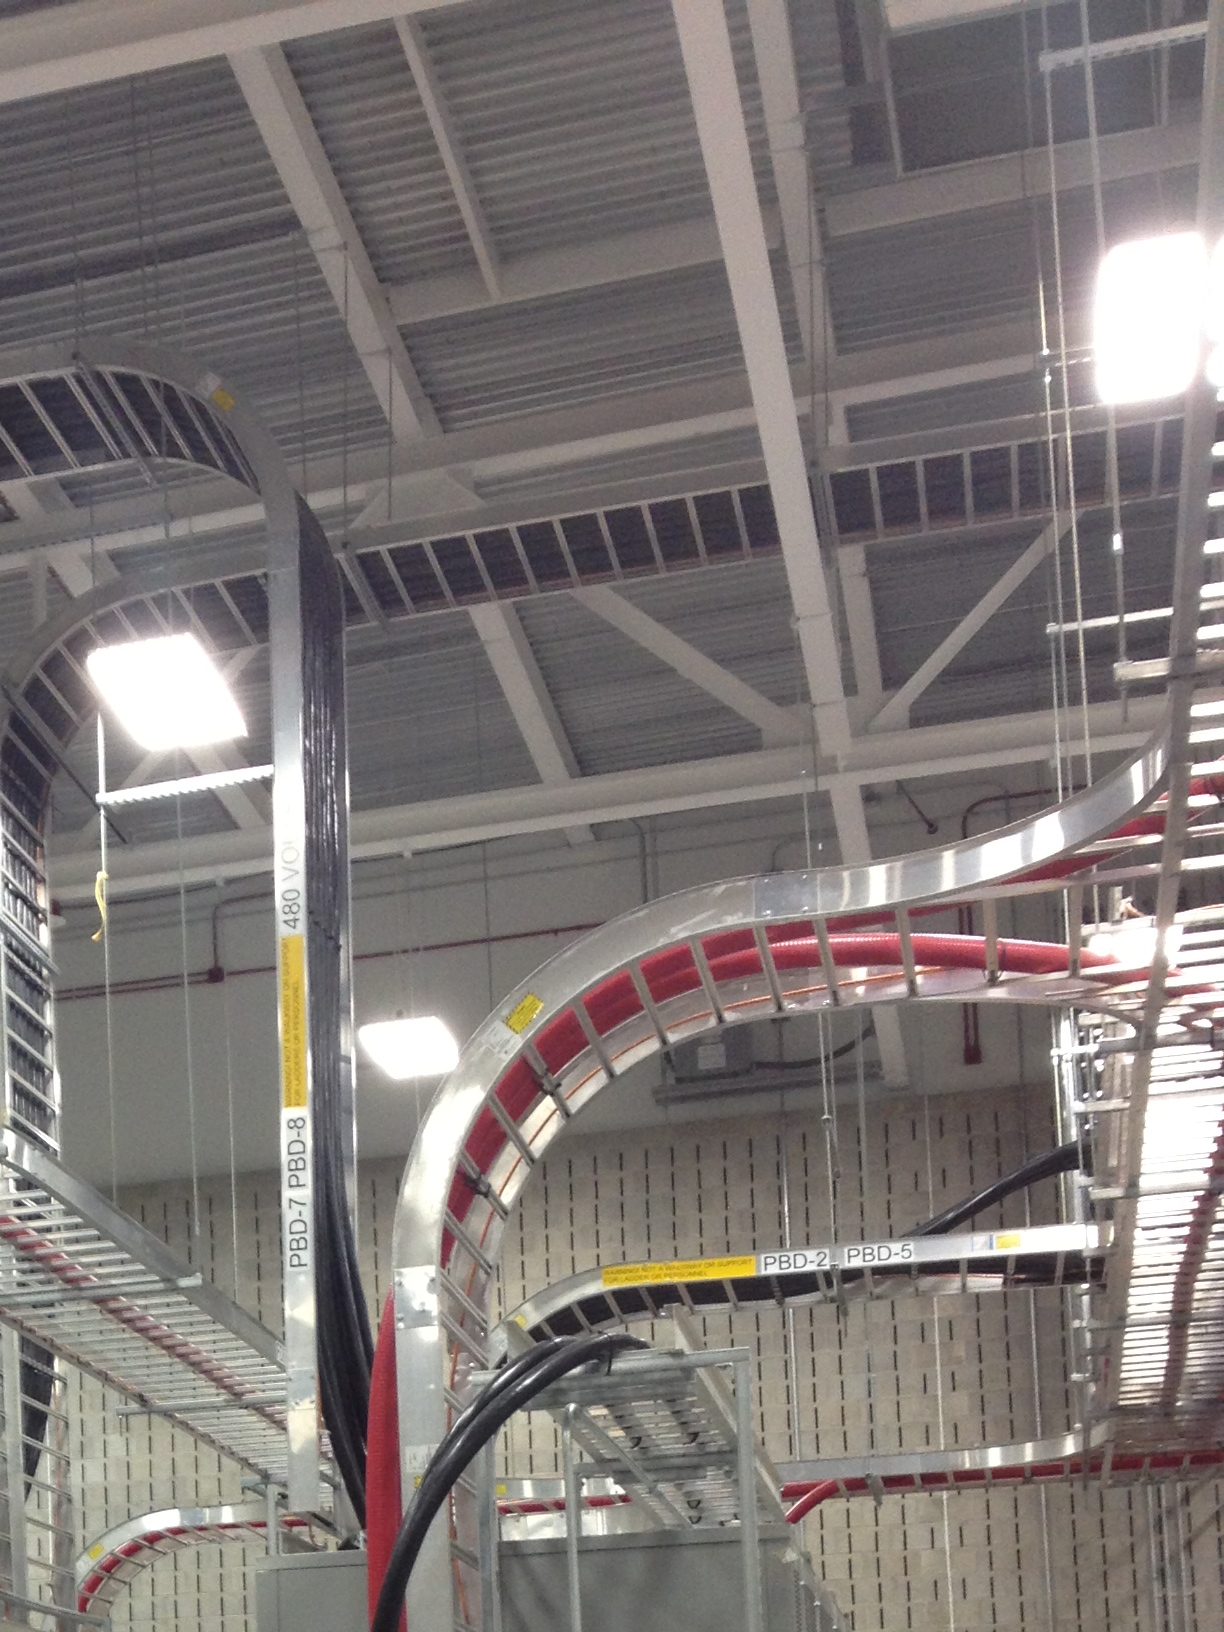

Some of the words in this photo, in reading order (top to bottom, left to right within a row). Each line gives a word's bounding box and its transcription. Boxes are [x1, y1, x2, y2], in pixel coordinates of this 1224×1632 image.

[281, 888, 300, 930] 480
[284, 1046, 292, 1063] NOT
[287, 1117, 307, 1188] PBD-8
[288, 1198, 308, 1268] PBD-7
[763, 1251, 828, 1271] PBD-2
[847, 1243, 913, 1264] PBD-5
